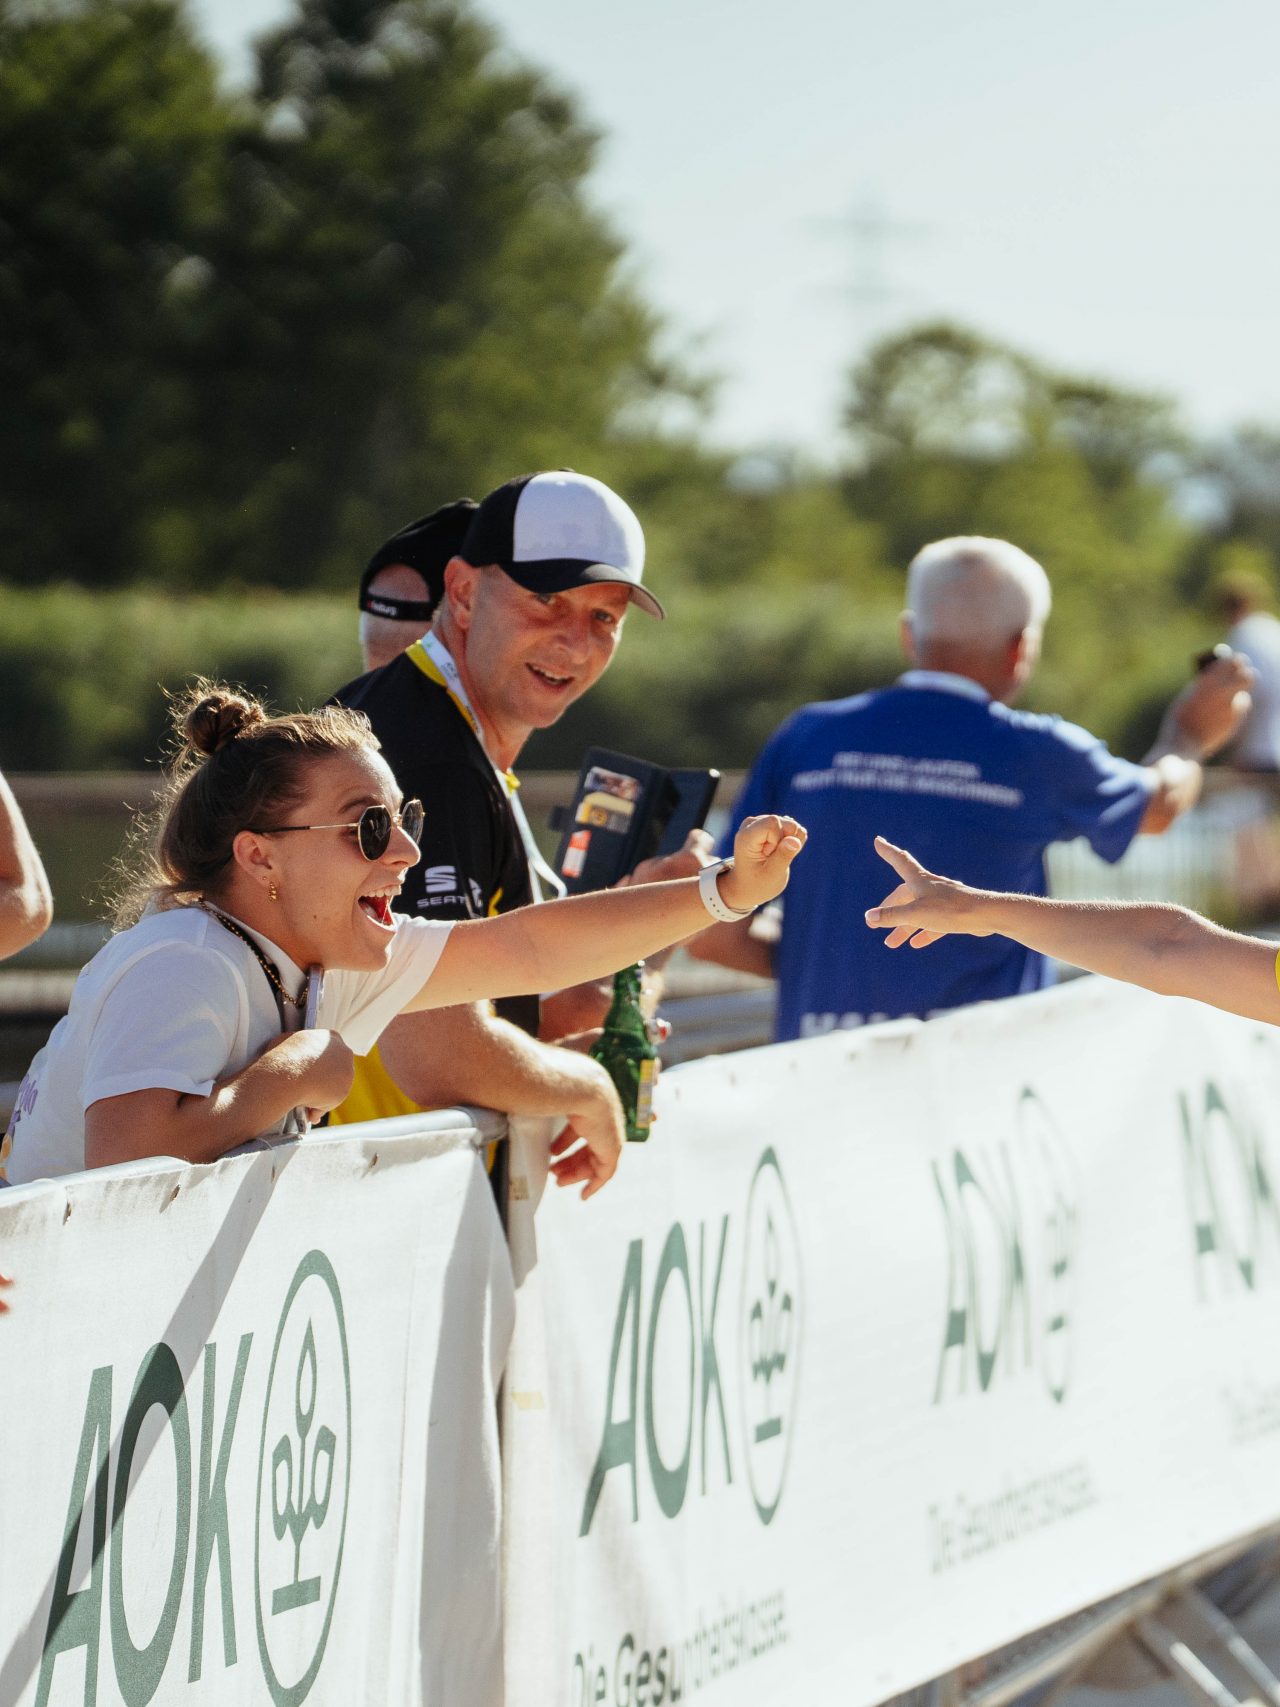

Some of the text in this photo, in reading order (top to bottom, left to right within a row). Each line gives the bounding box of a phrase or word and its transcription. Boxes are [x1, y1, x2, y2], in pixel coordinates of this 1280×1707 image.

[417, 895, 466, 909] SEAT
[34, 1332, 254, 1707] AOK
[578, 1213, 733, 1540] AOK
